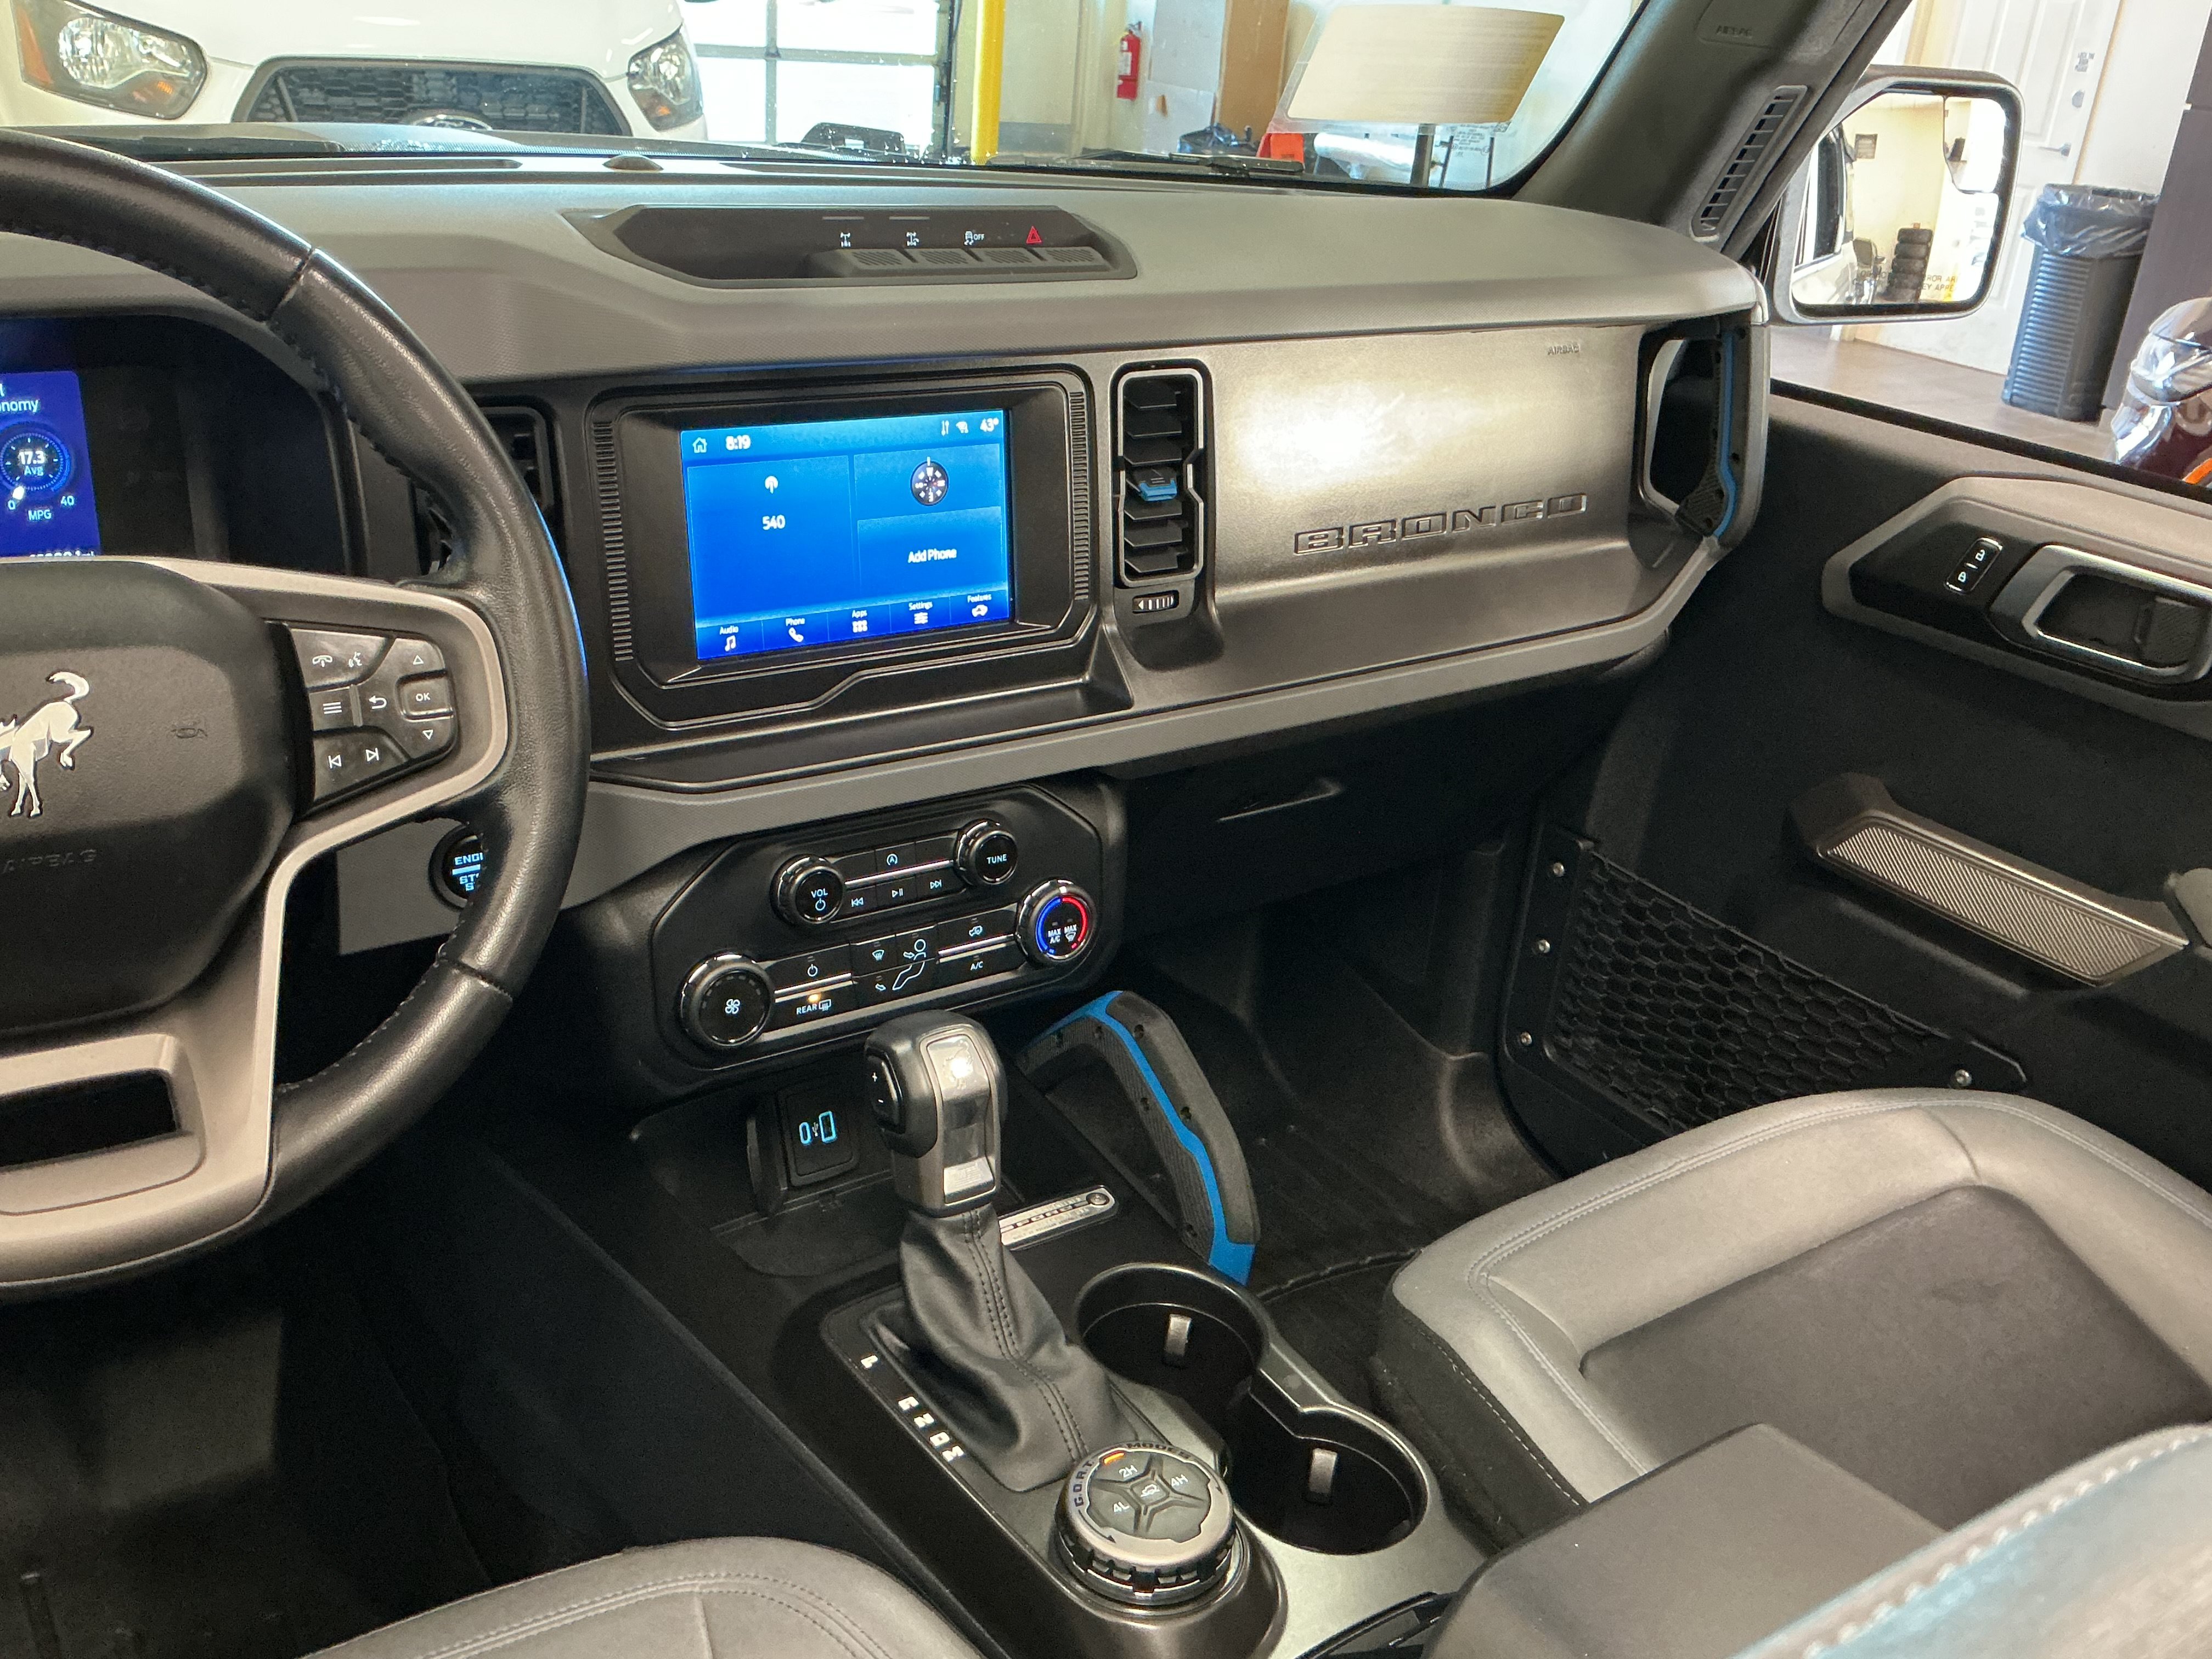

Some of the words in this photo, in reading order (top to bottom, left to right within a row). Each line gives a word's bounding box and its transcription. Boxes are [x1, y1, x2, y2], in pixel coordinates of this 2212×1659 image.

[1547, 343, 1581, 356] AIRBAG
[0, 399, 40, 413] nomy
[726, 435, 751, 450] 8:19
[18, 450, 45, 465] 17.3
[7, 499, 16, 510] 0
[60, 495, 75, 506] 40
[27, 509, 52, 521] MPG
[762, 515, 786, 530] 540
[1293, 493, 1587, 556] BRONCO
[907, 549, 927, 563] Add
[927, 548, 957, 561] Phone
[967, 594, 992, 603] Features
[909, 601, 933, 611] Settings
[851, 610, 868, 619] Apps
[785, 618, 805, 627] Phone
[719, 625, 739, 635] Audio
[415, 692, 431, 702] OK
[454, 852, 483, 866] ENGI
[986, 853, 1008, 864] TUNE
[810, 888, 828, 898] VOL
[1048, 928, 1061, 938] MAX
[1064, 924, 1077, 934] MAX
[1049, 935, 1060, 944] A/C
[970, 960, 984, 970] A/C
[796, 1003, 817, 1015] REAR
[913, 1413, 935, 1428] N
[1126, 1442, 1191, 1459] MODES
[1118, 1464, 1138, 1480] 2H
[1170, 1474, 1189, 1488] 4H
[1113, 1501, 1131, 1514] 4L
